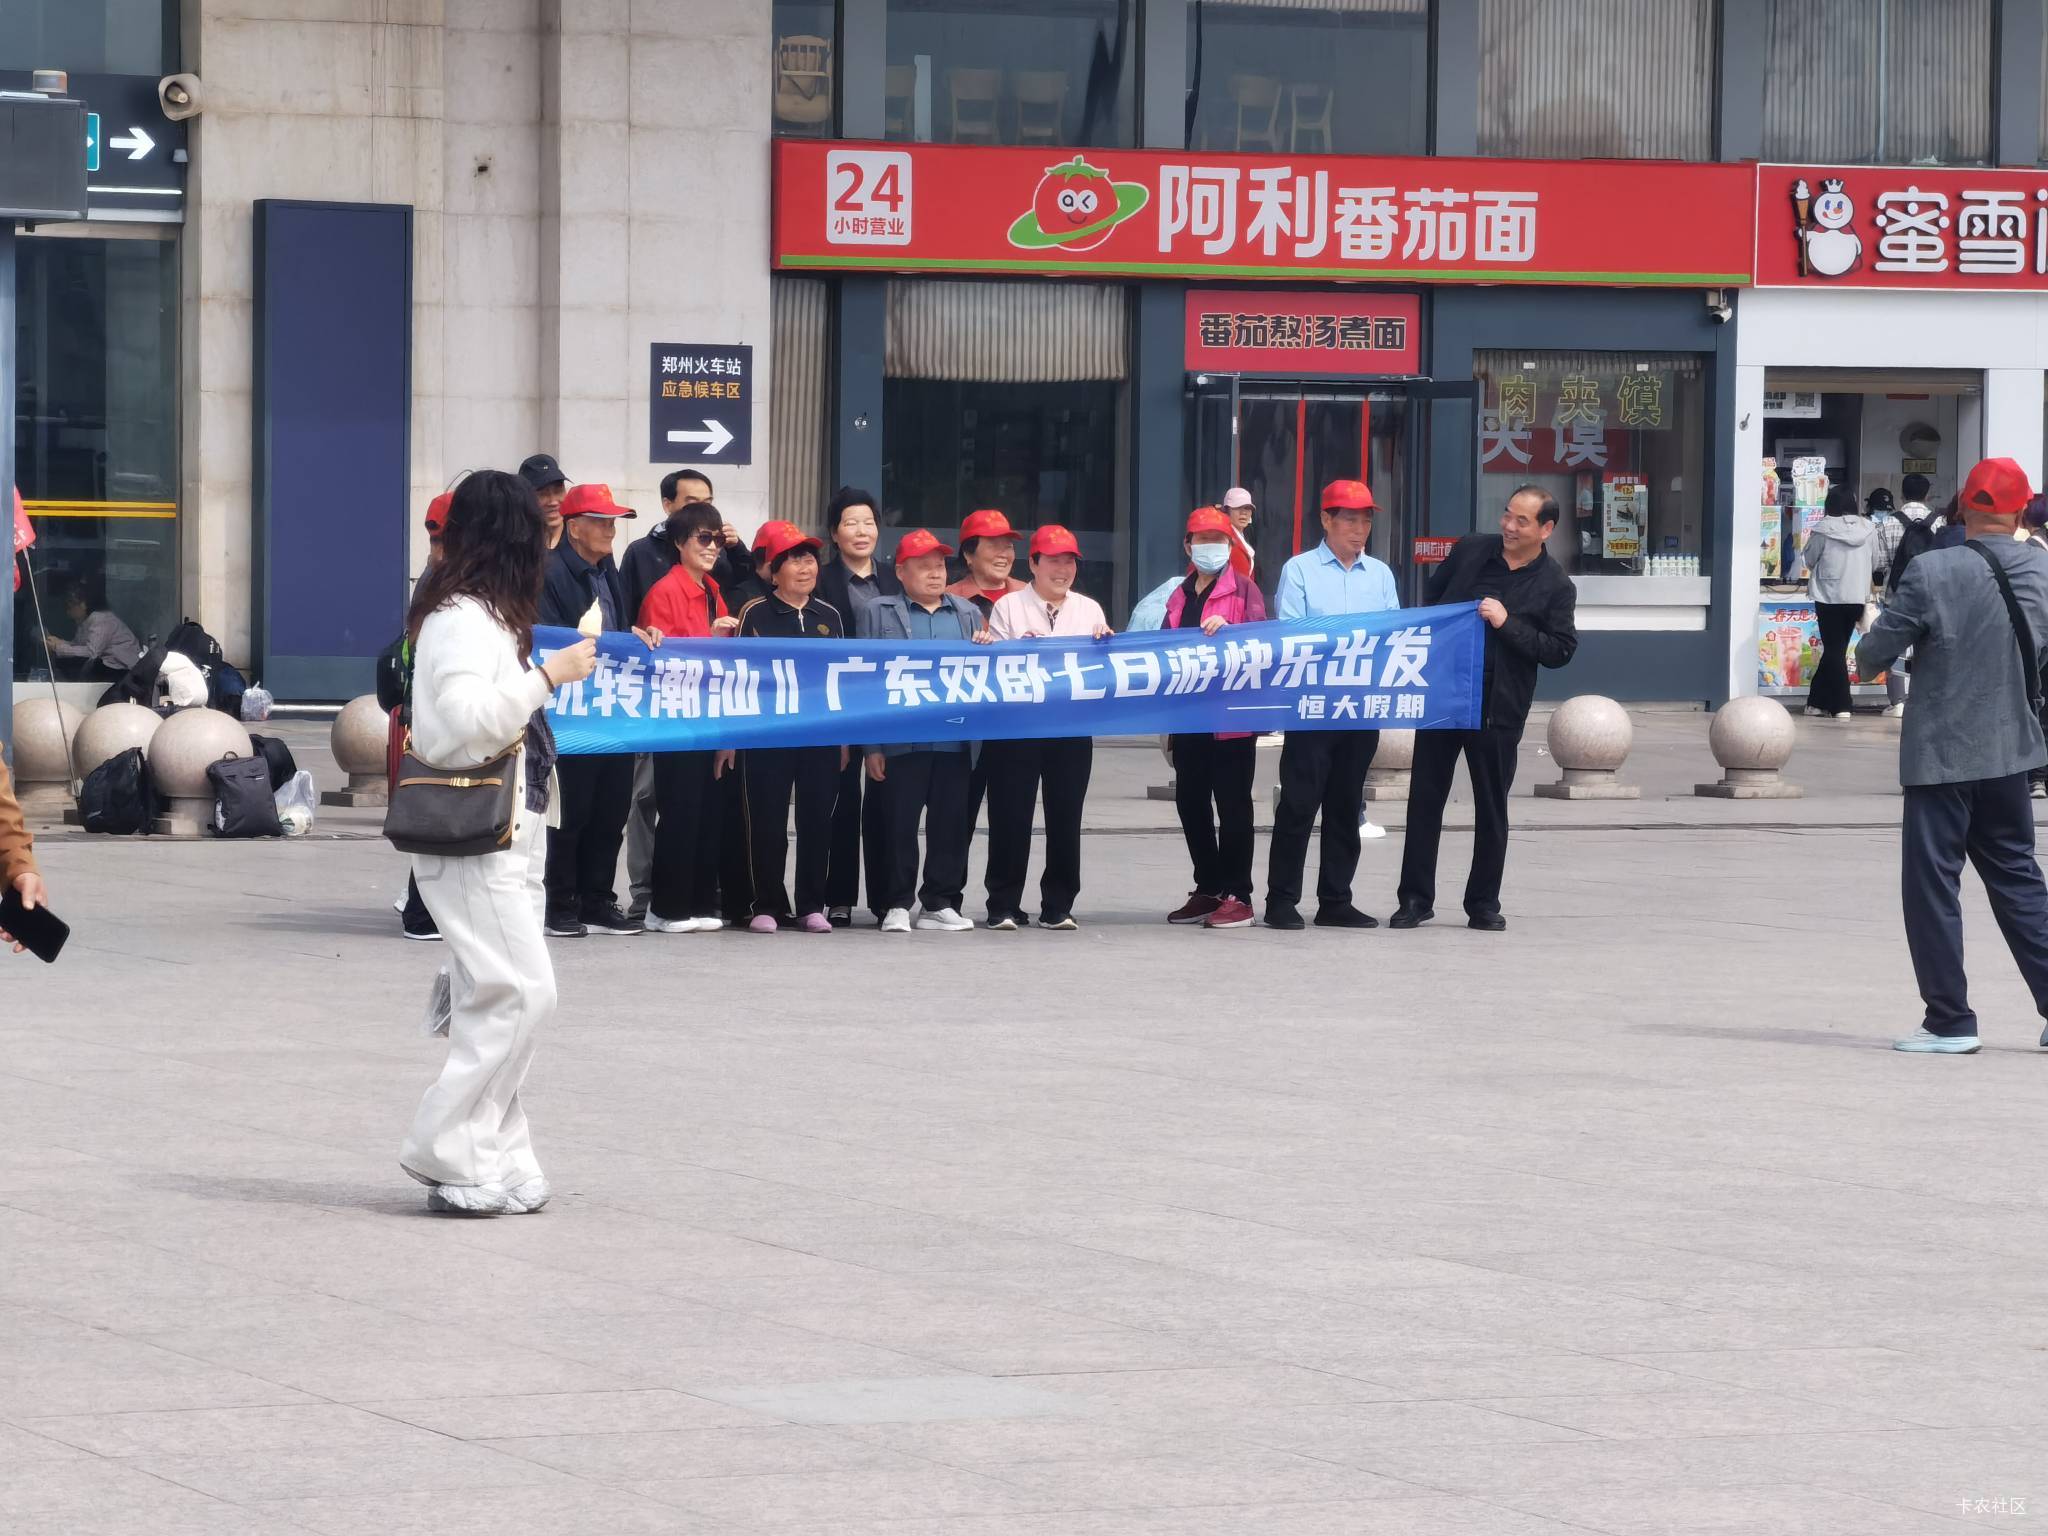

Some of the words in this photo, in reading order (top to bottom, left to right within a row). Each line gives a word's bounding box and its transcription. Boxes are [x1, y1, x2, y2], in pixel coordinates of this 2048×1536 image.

[833, 162, 905, 213] 24
[833, 215, 905, 237] 小时营业
[1158, 164, 1539, 262] 阿利番茄面
[1199, 311, 1407, 352] 番茄熬汤煮面
[661, 355, 742, 376] 郑州火车站
[661, 379, 741, 399] 应急候车区
[1500, 374, 1663, 426] 肉夹馍
[1297, 693, 1426, 721] 恒大假期
